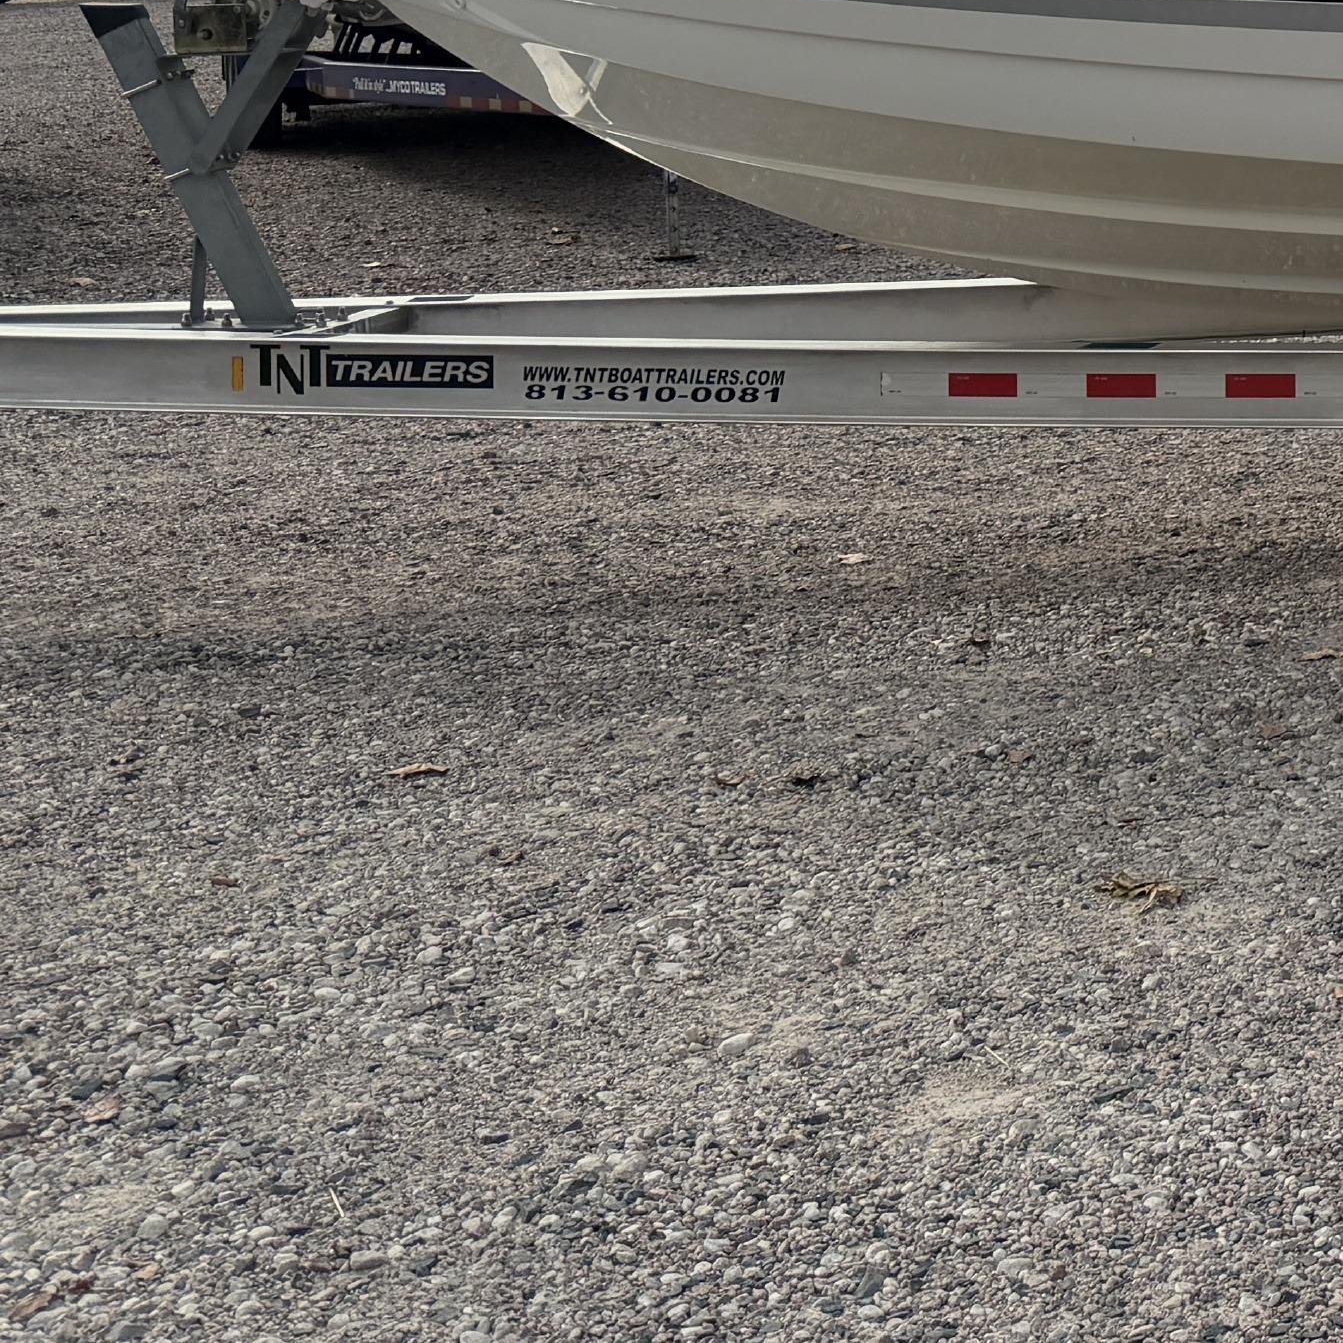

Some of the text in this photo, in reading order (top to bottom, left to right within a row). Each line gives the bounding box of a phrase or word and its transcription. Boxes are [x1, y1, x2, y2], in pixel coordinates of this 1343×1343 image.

[250, 344, 491, 395] TNT TRAILERS
[523, 366, 785, 386] WWW.TNTBOATTRAILERS.COM
[524, 384, 781, 403] 813-610-0081
